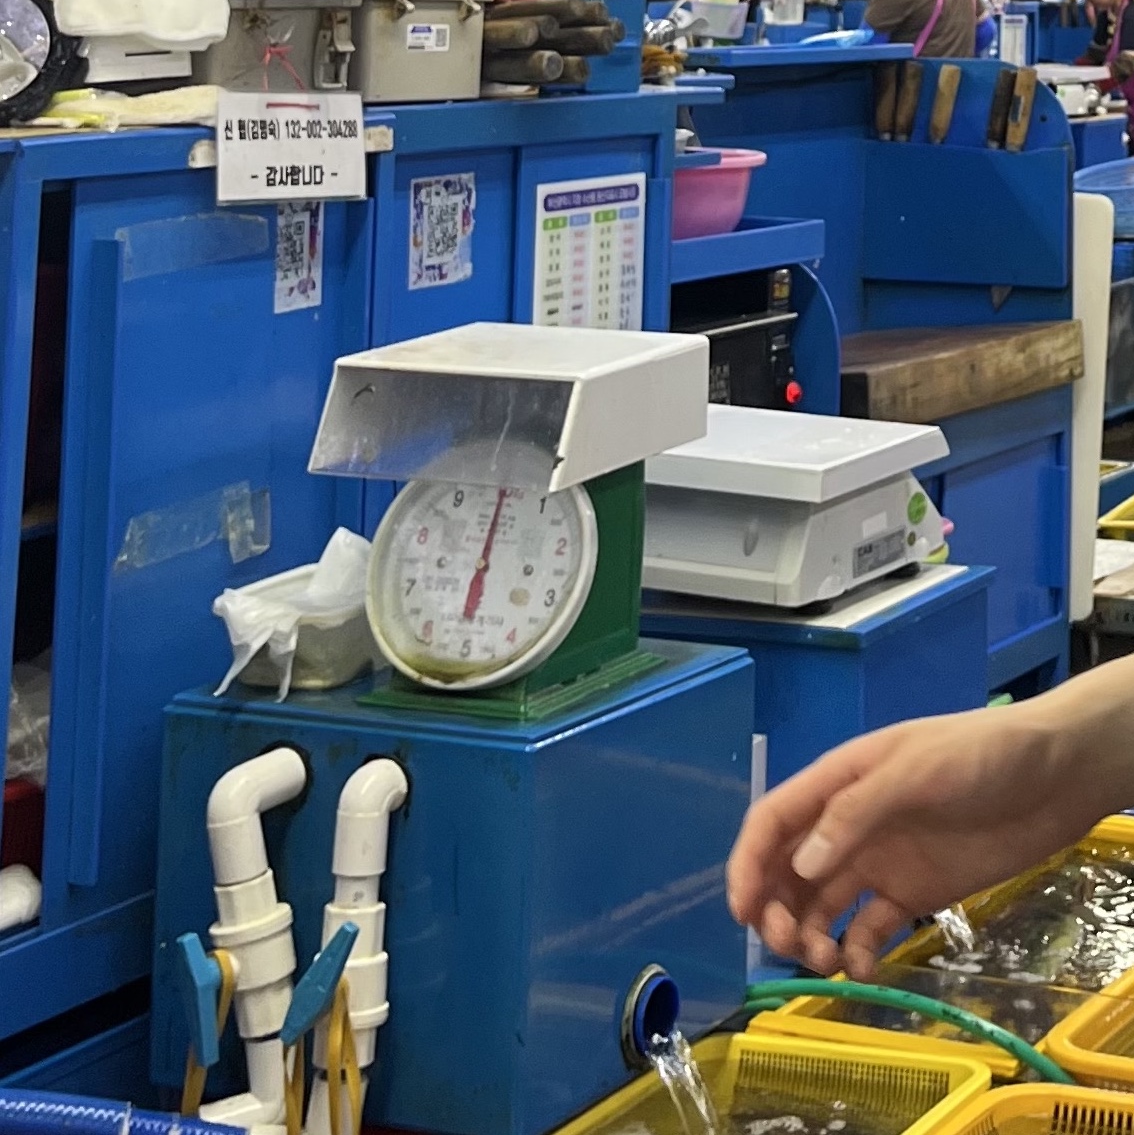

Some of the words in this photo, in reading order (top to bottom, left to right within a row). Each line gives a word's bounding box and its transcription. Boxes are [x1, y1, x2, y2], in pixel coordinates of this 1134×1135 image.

[224, 119, 234, 140] 신
[265, 164, 325, 187] 감사합니다
[453, 489, 466, 509] 9
[539, 495, 548, 515] 1
[416, 526, 429, 545] 8
[555, 537, 568, 556] 2
[405, 578, 417, 597] 7
[544, 588, 556, 608] 3
[506, 627, 518, 645] 4
[460, 639, 473, 659] 5
